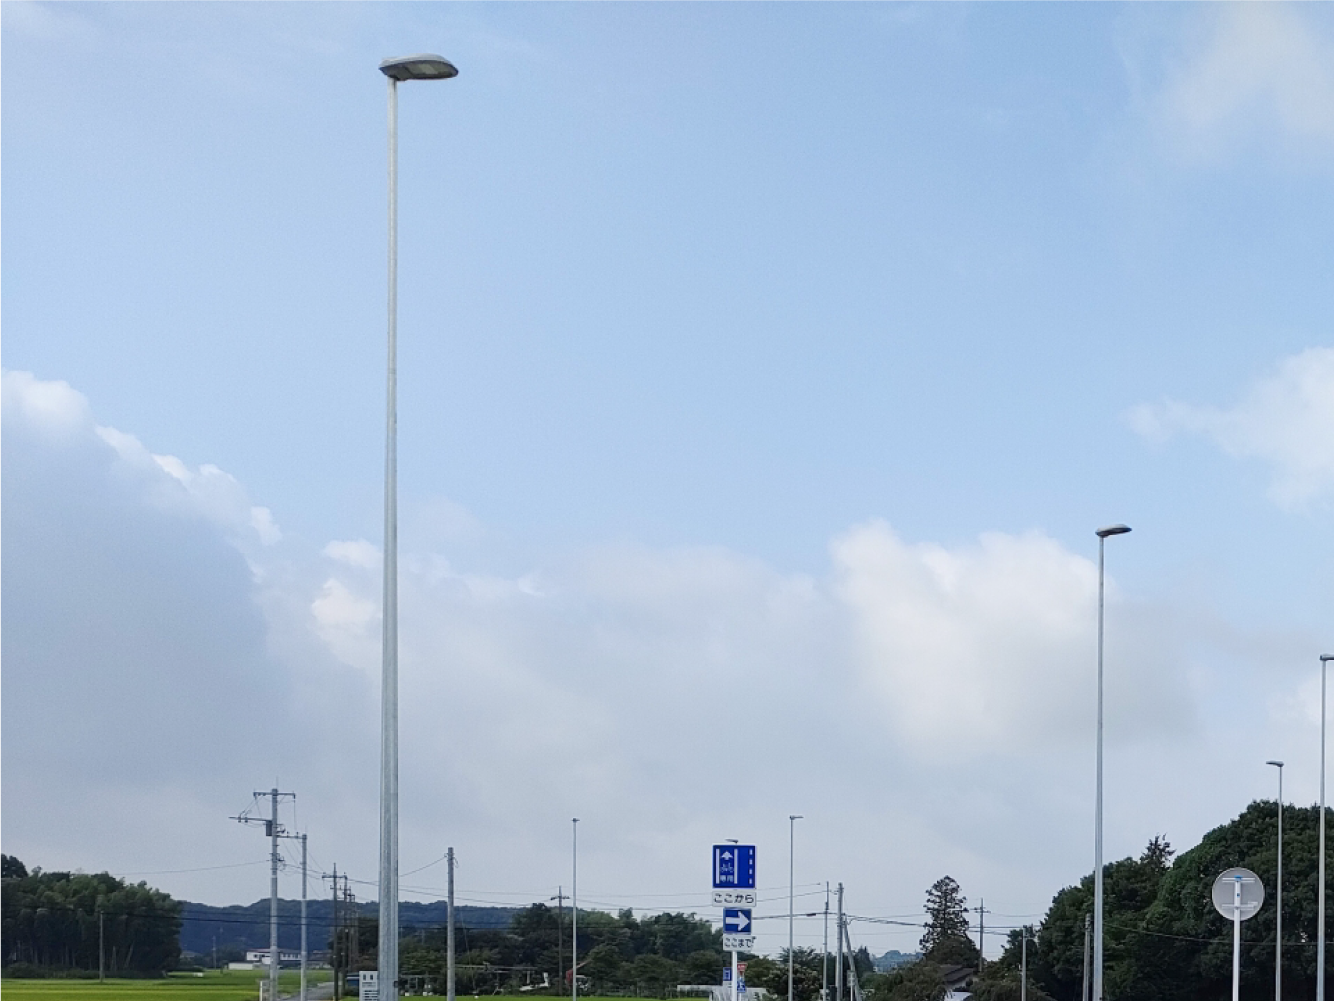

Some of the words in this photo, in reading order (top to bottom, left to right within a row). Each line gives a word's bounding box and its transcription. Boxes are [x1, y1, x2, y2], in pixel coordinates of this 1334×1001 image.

[714, 893, 754, 904] ここから
[725, 936, 756, 948] ここまで
